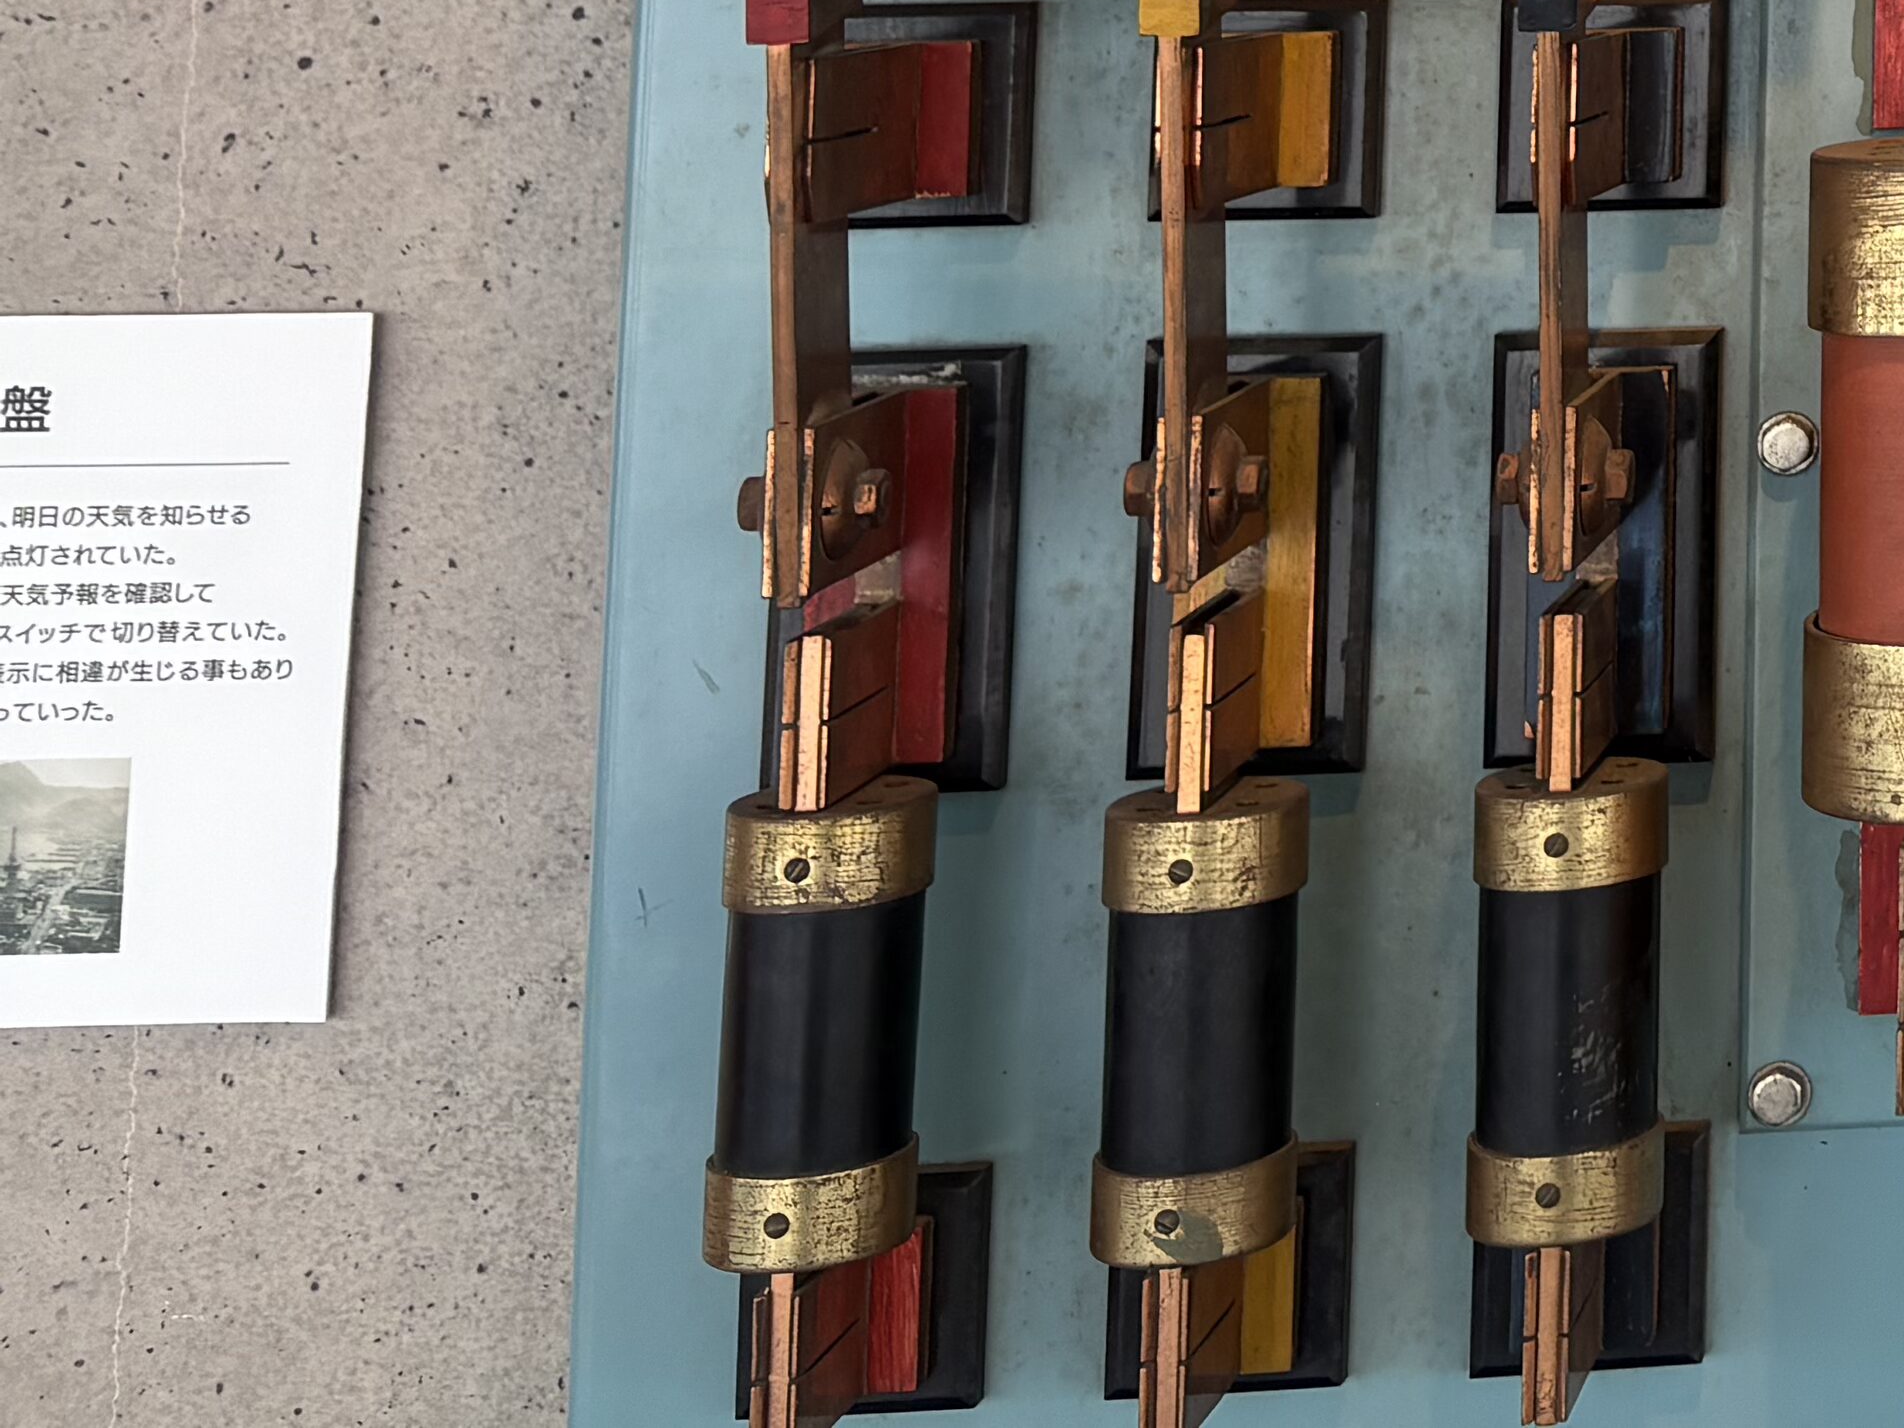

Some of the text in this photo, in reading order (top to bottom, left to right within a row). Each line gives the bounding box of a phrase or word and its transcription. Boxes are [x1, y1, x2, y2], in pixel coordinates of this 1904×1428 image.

[0, 384, 53, 434] 盤
[0, 543, 176, 568] 点灯されていた。
[0, 581, 216, 607] 天気予報を確認して
[0, 658, 294, 685] 示に相違が生じる事もあり
